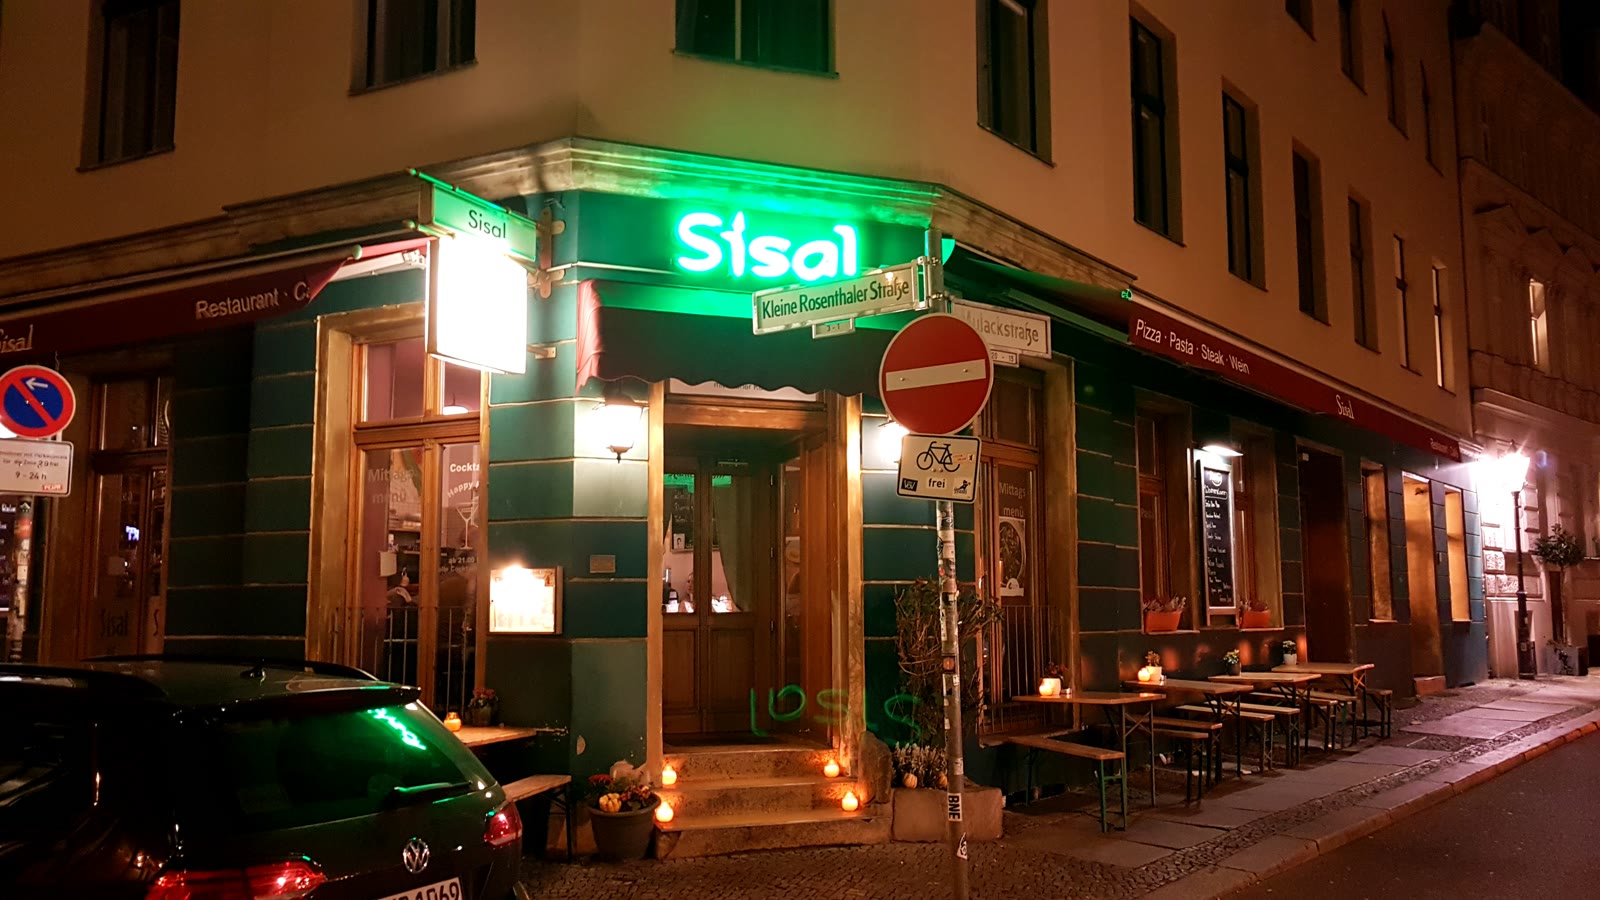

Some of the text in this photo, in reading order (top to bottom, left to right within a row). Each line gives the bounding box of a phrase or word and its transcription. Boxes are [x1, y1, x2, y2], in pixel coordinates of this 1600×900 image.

[468, 209, 507, 239] Sisal
[676, 210, 858, 281] Sisal
[195, 288, 279, 320] Restaurant
[762, 280, 909, 320] Kleine Rosenthaler Straße
[1135, 318, 1250, 375] Pizza Pasta Steak Wein
[1335, 394, 1355, 419] Sisal
[29, 471, 39, 479] 24
[928, 478, 946, 488] frei
[447, 481, 473, 498] Happy
[999, 482, 1026, 499] Mittags
[948, 795, 961, 820] BNE
